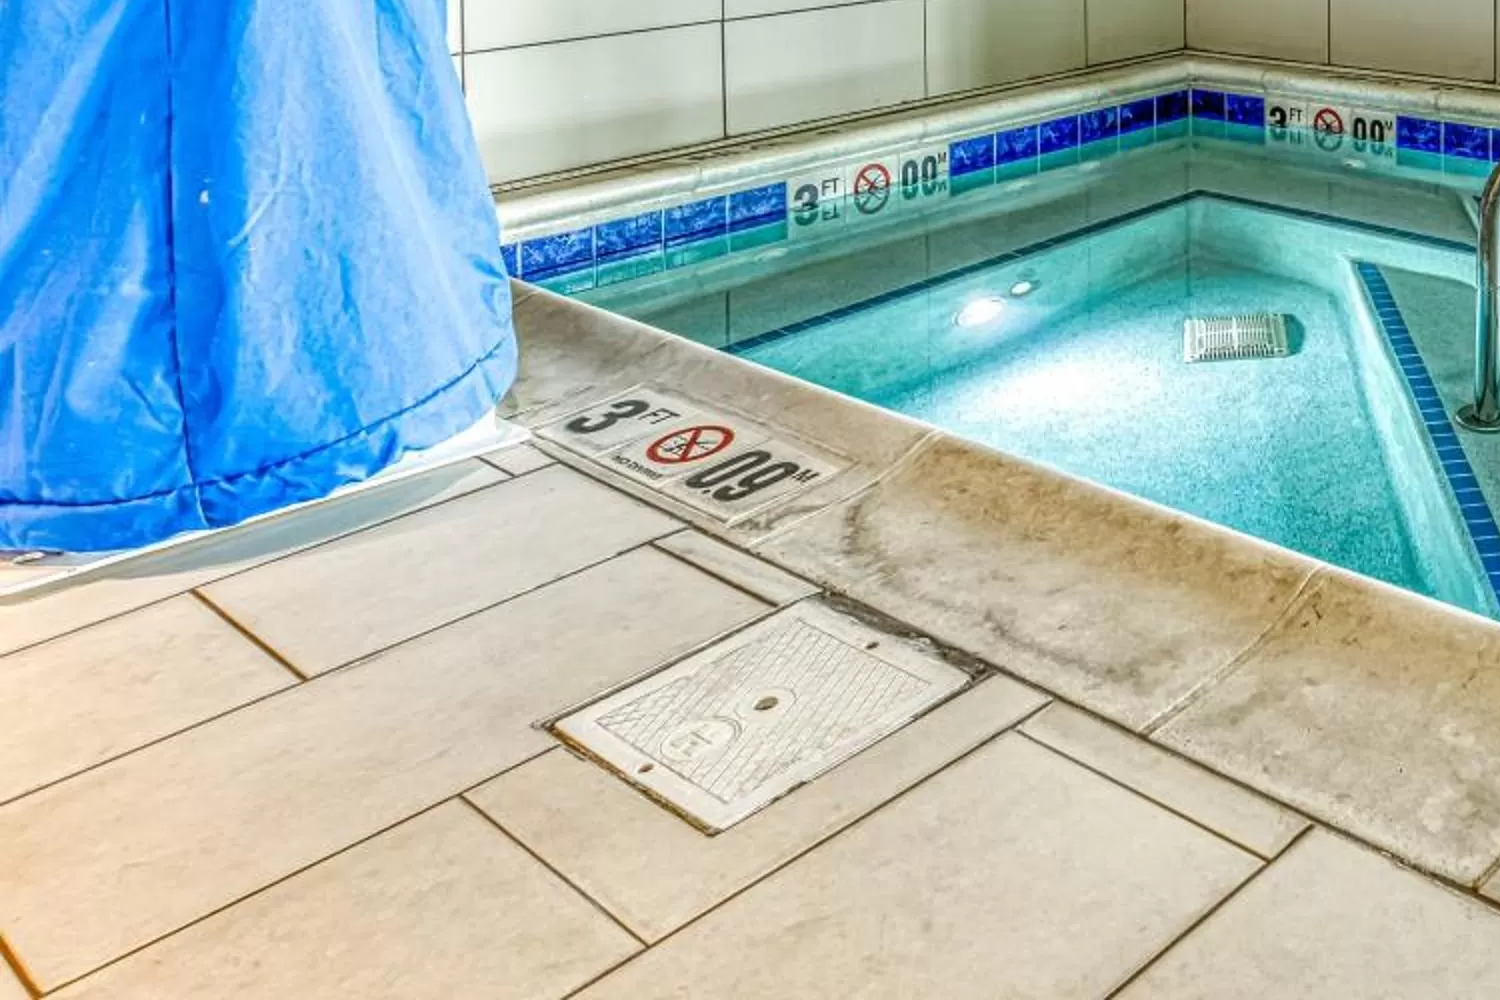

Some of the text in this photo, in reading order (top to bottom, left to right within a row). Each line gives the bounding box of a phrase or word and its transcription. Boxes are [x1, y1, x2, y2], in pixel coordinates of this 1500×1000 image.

[821, 178, 839, 196] FT
[565, 400, 650, 434] 3
[638, 407, 680, 424] FT
